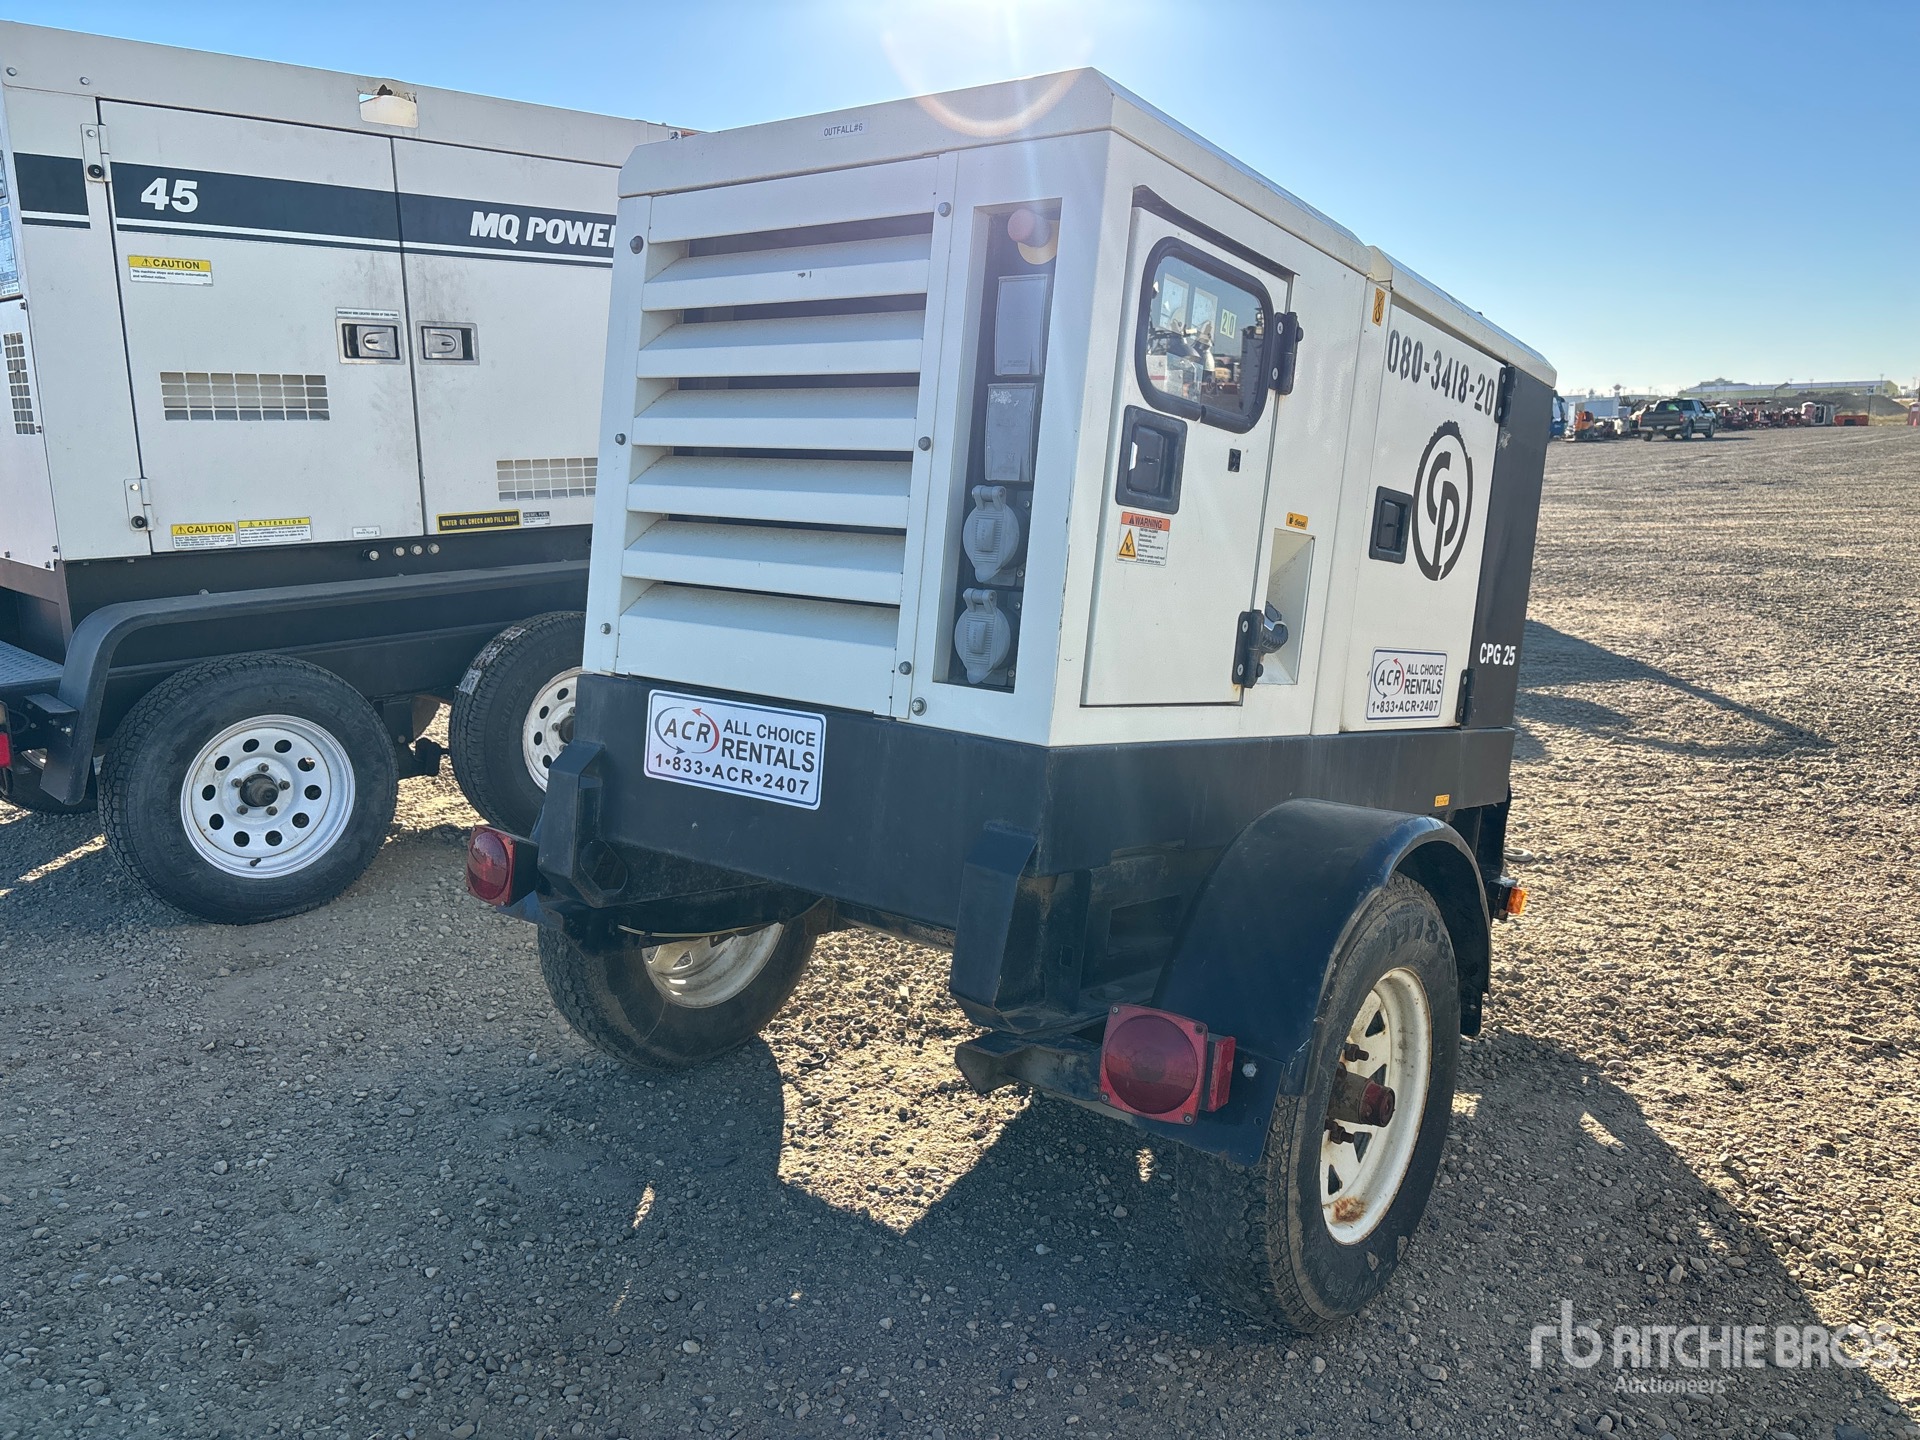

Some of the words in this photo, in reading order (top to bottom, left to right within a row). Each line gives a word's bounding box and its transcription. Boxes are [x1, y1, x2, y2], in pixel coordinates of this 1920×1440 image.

[824, 123, 863, 136] OUTFALL#6
[141, 177, 198, 213] 45
[470, 211, 520, 244] MQ
[152, 259, 200, 270] CAUTION
[1221, 312, 1235, 336] 20
[1387, 330, 1495, 416] 080-3418-20
[186, 524, 232, 533] CAUTION
[1135, 516, 1162, 528] WARNING
[1480, 642, 1501, 664] CPG
[1502, 646, 1516, 666] 25
[1378, 670, 1400, 686] ACR
[1406, 664, 1419, 676] ALL
[1420, 664, 1443, 676] CHOICE
[1404, 679, 1442, 694] RENTALS
[664, 718, 711, 743] ACR
[723, 719, 751, 736] ALL
[756, 724, 816, 747] CHOICE
[721, 738, 815, 772] RENTALS
